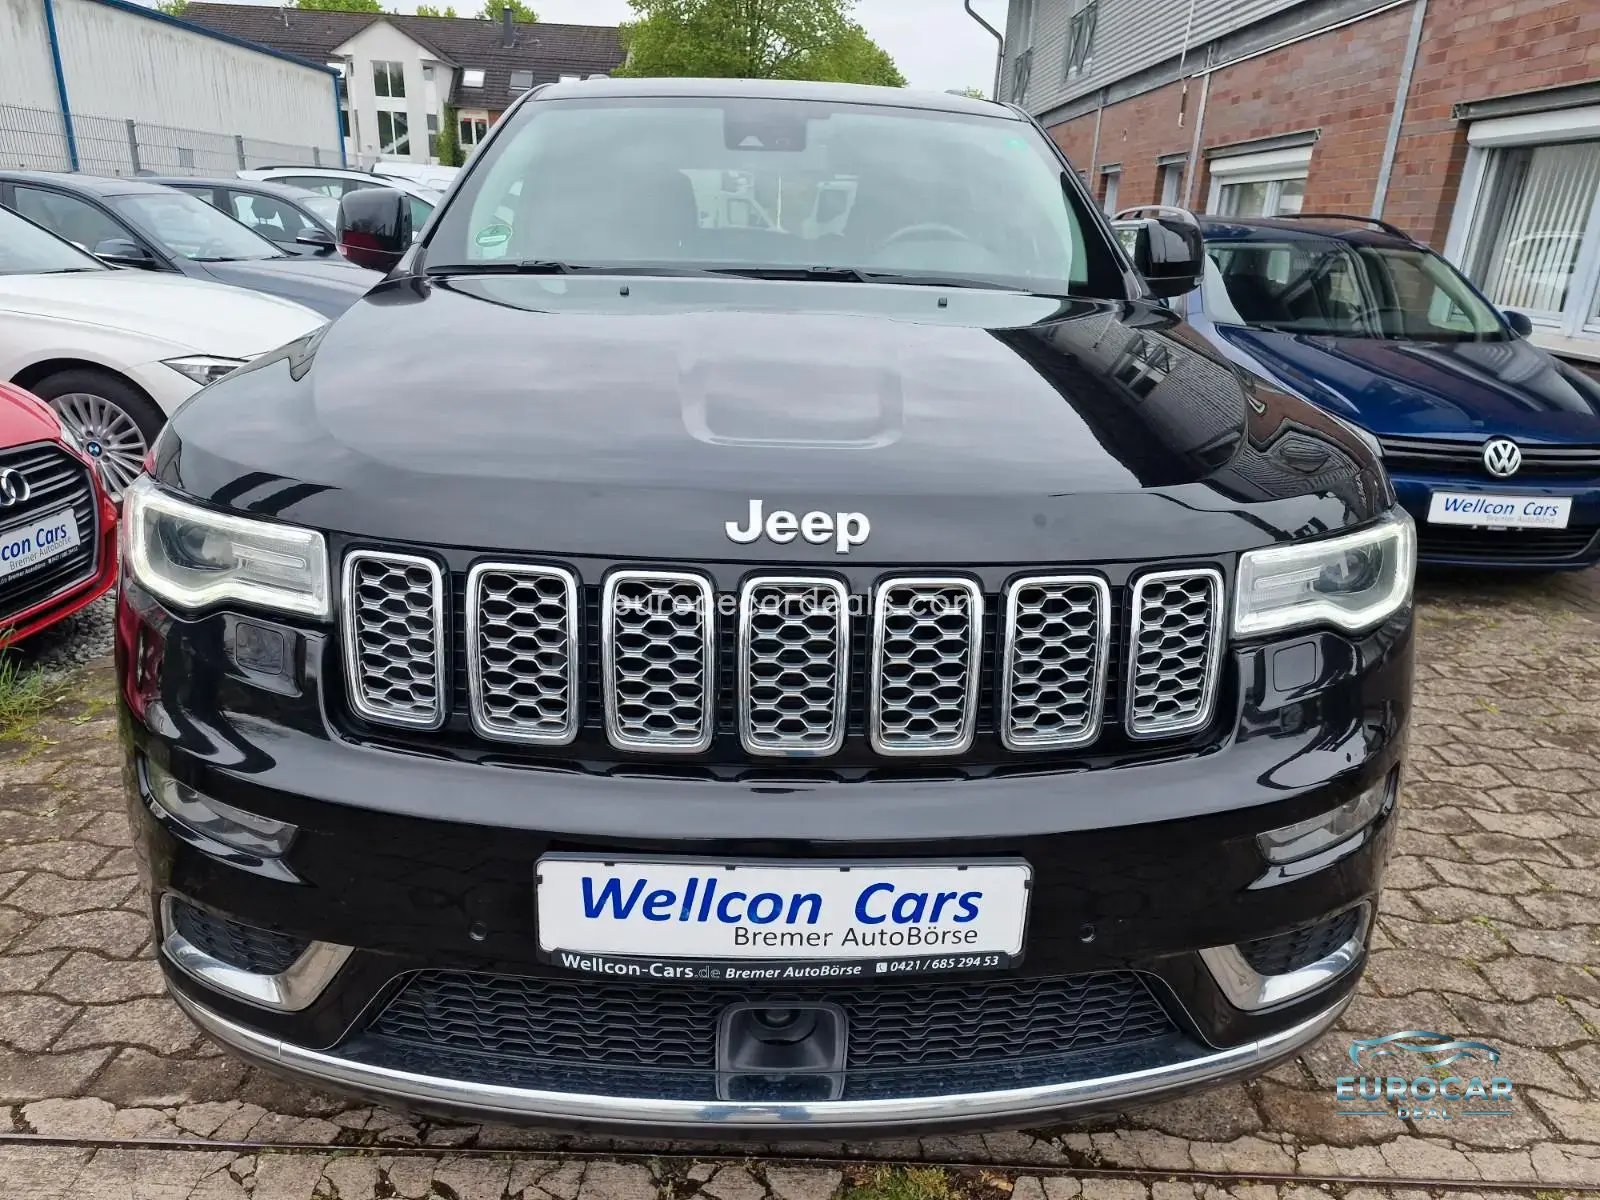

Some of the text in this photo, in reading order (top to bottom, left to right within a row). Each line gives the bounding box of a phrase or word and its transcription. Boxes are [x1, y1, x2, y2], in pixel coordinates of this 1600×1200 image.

[1443, 496, 1560, 516] Wellcon Cars
[36, 524, 67, 548] Cars
[725, 499, 871, 555] Jeep
[581, 876, 984, 926] Wellcon Cars
[734, 926, 978, 948] Bremer AutoBörse
[561, 953, 721, 979] Wellcon-Cars.de
[725, 967, 781, 980] Bremer
[783, 963, 862, 978] AutoBörse
[891, 959, 921, 972] 0421
[932, 957, 955, 970] 685
[957, 956, 981, 969] 294
[983, 955, 1000, 967] 53
